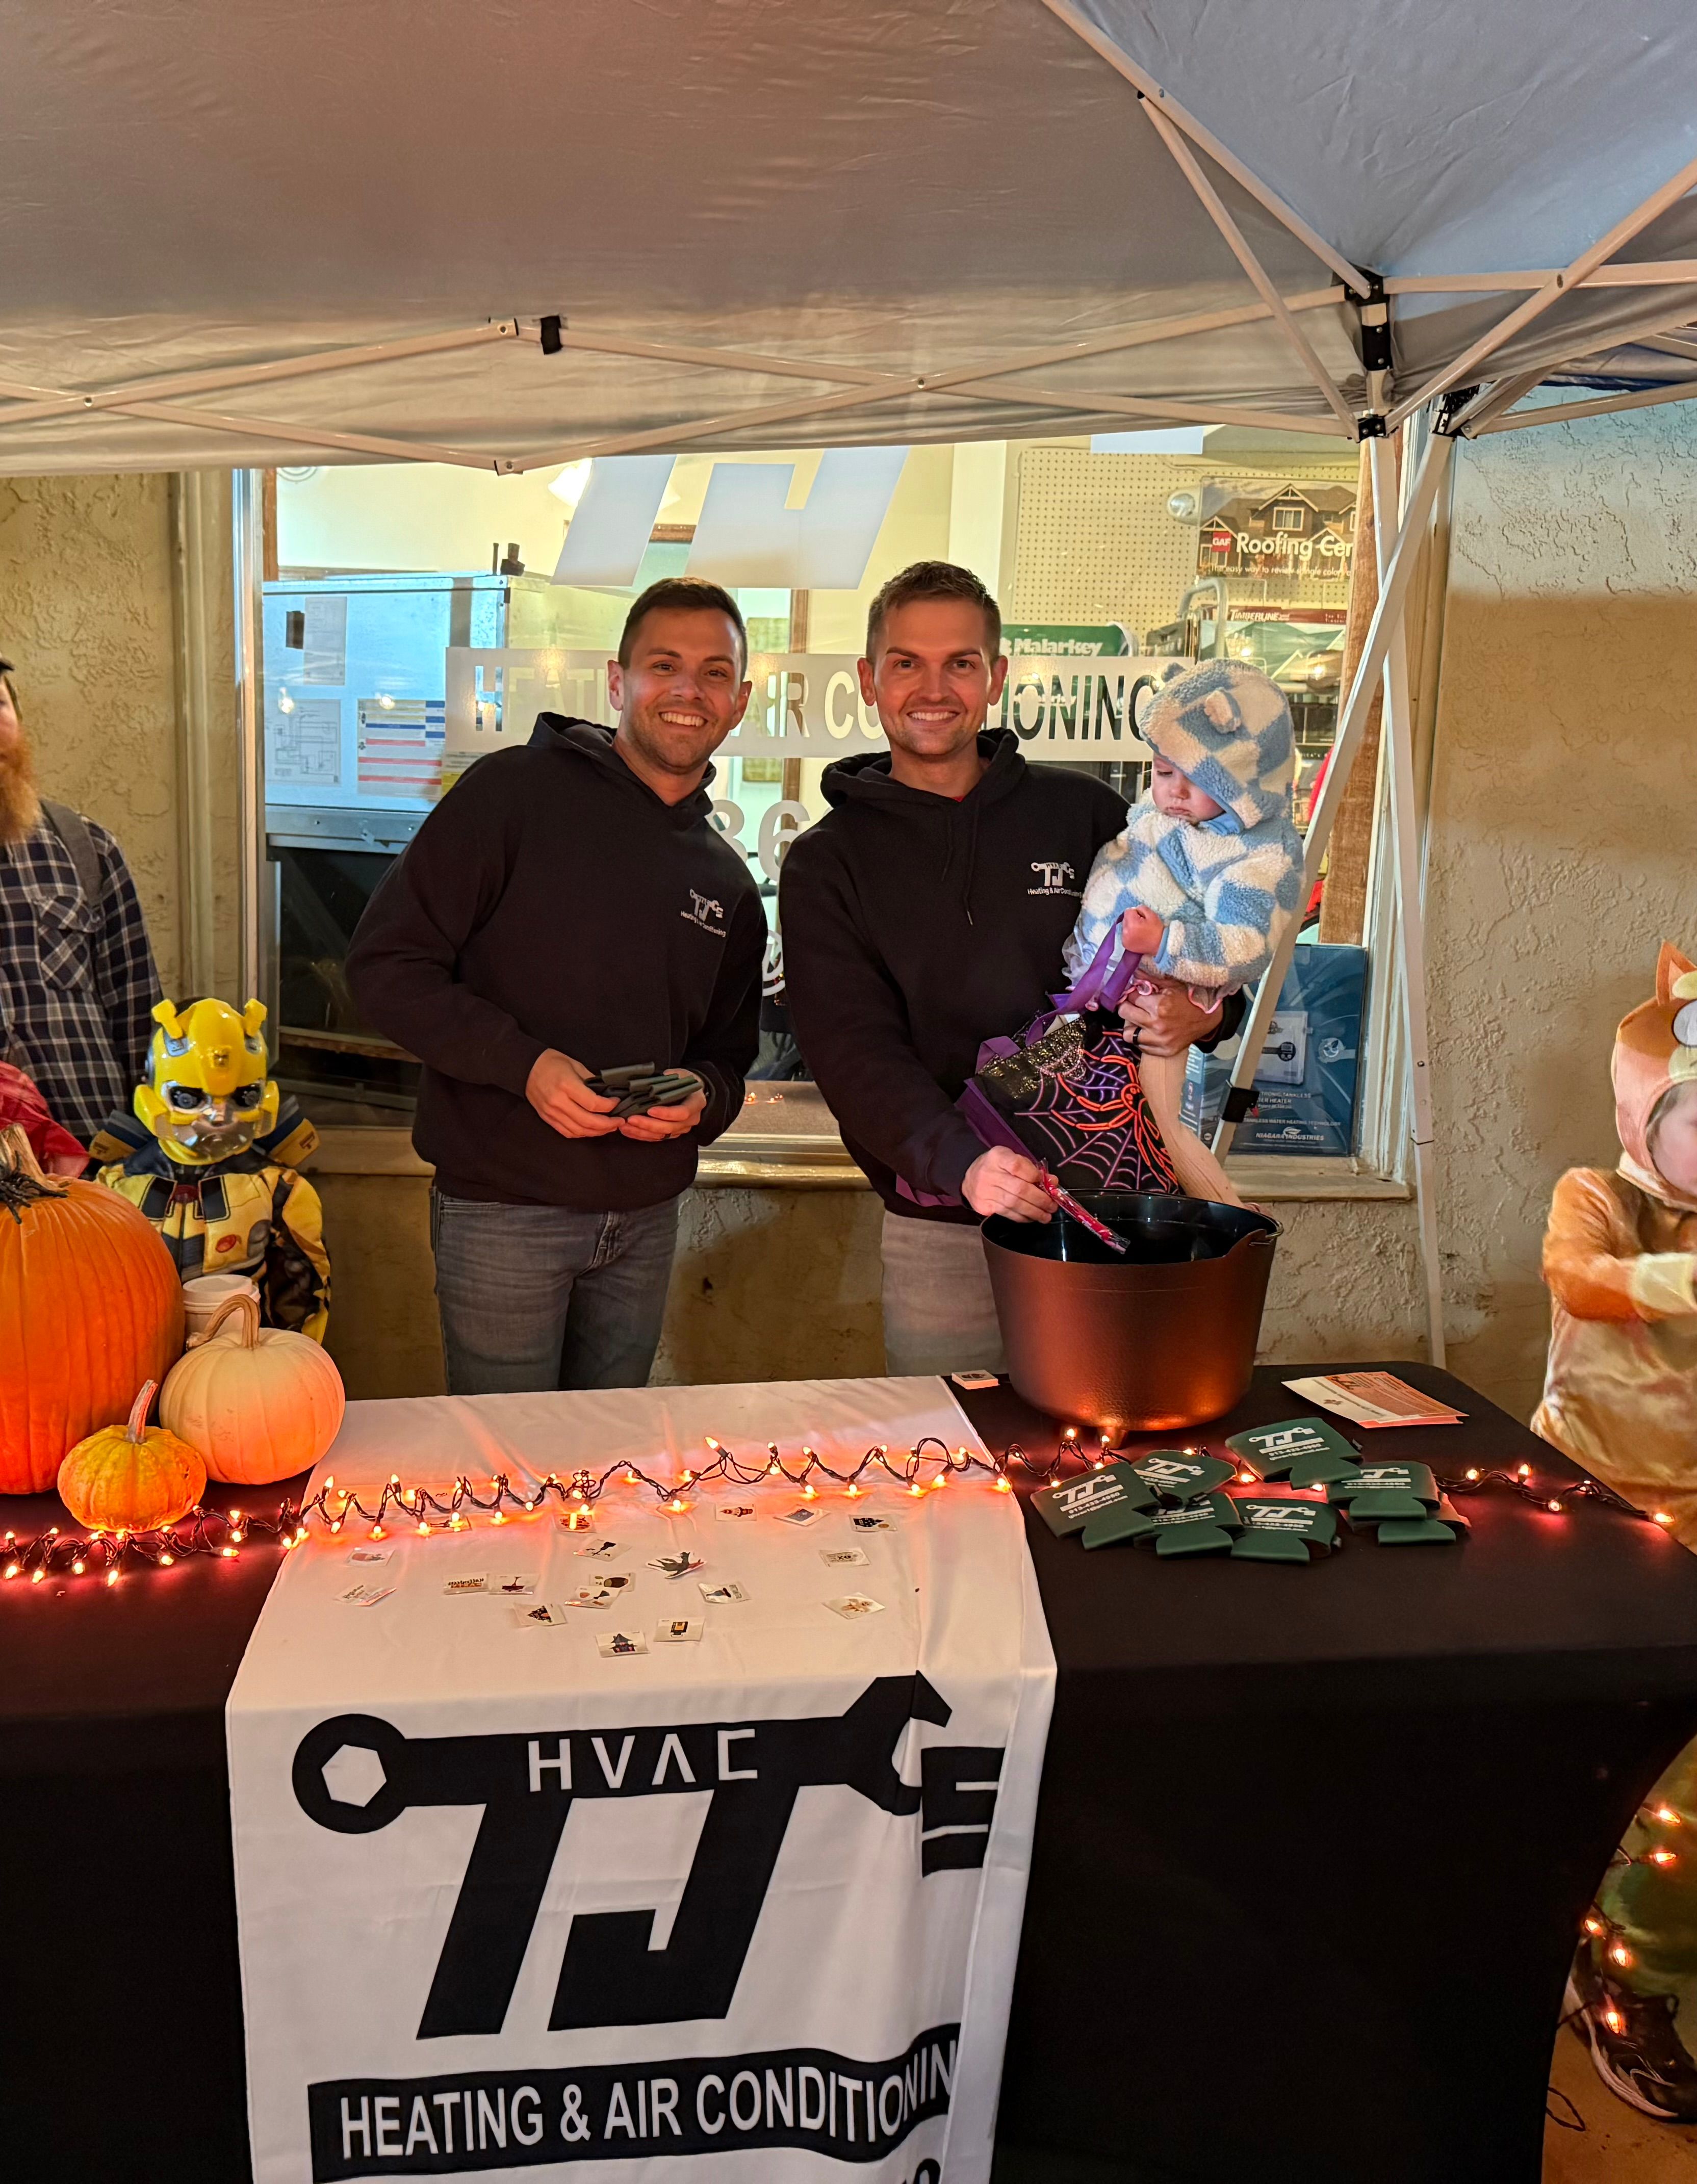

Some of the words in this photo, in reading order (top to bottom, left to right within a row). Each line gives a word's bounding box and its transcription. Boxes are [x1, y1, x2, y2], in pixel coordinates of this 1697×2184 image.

[1213, 538, 1231, 546] GAF
[1237, 532, 1313, 561] Roofing
[1014, 638, 1103, 657] Malarkey
[731, 671, 810, 738] AIR
[528, 1729, 758, 1792] HVAC
[340, 2085, 545, 2159] HEATING
[560, 2081, 590, 2141] &
[604, 2077, 680, 2139] AIR
[696, 2039, 957, 2142] CONDITIONIN
